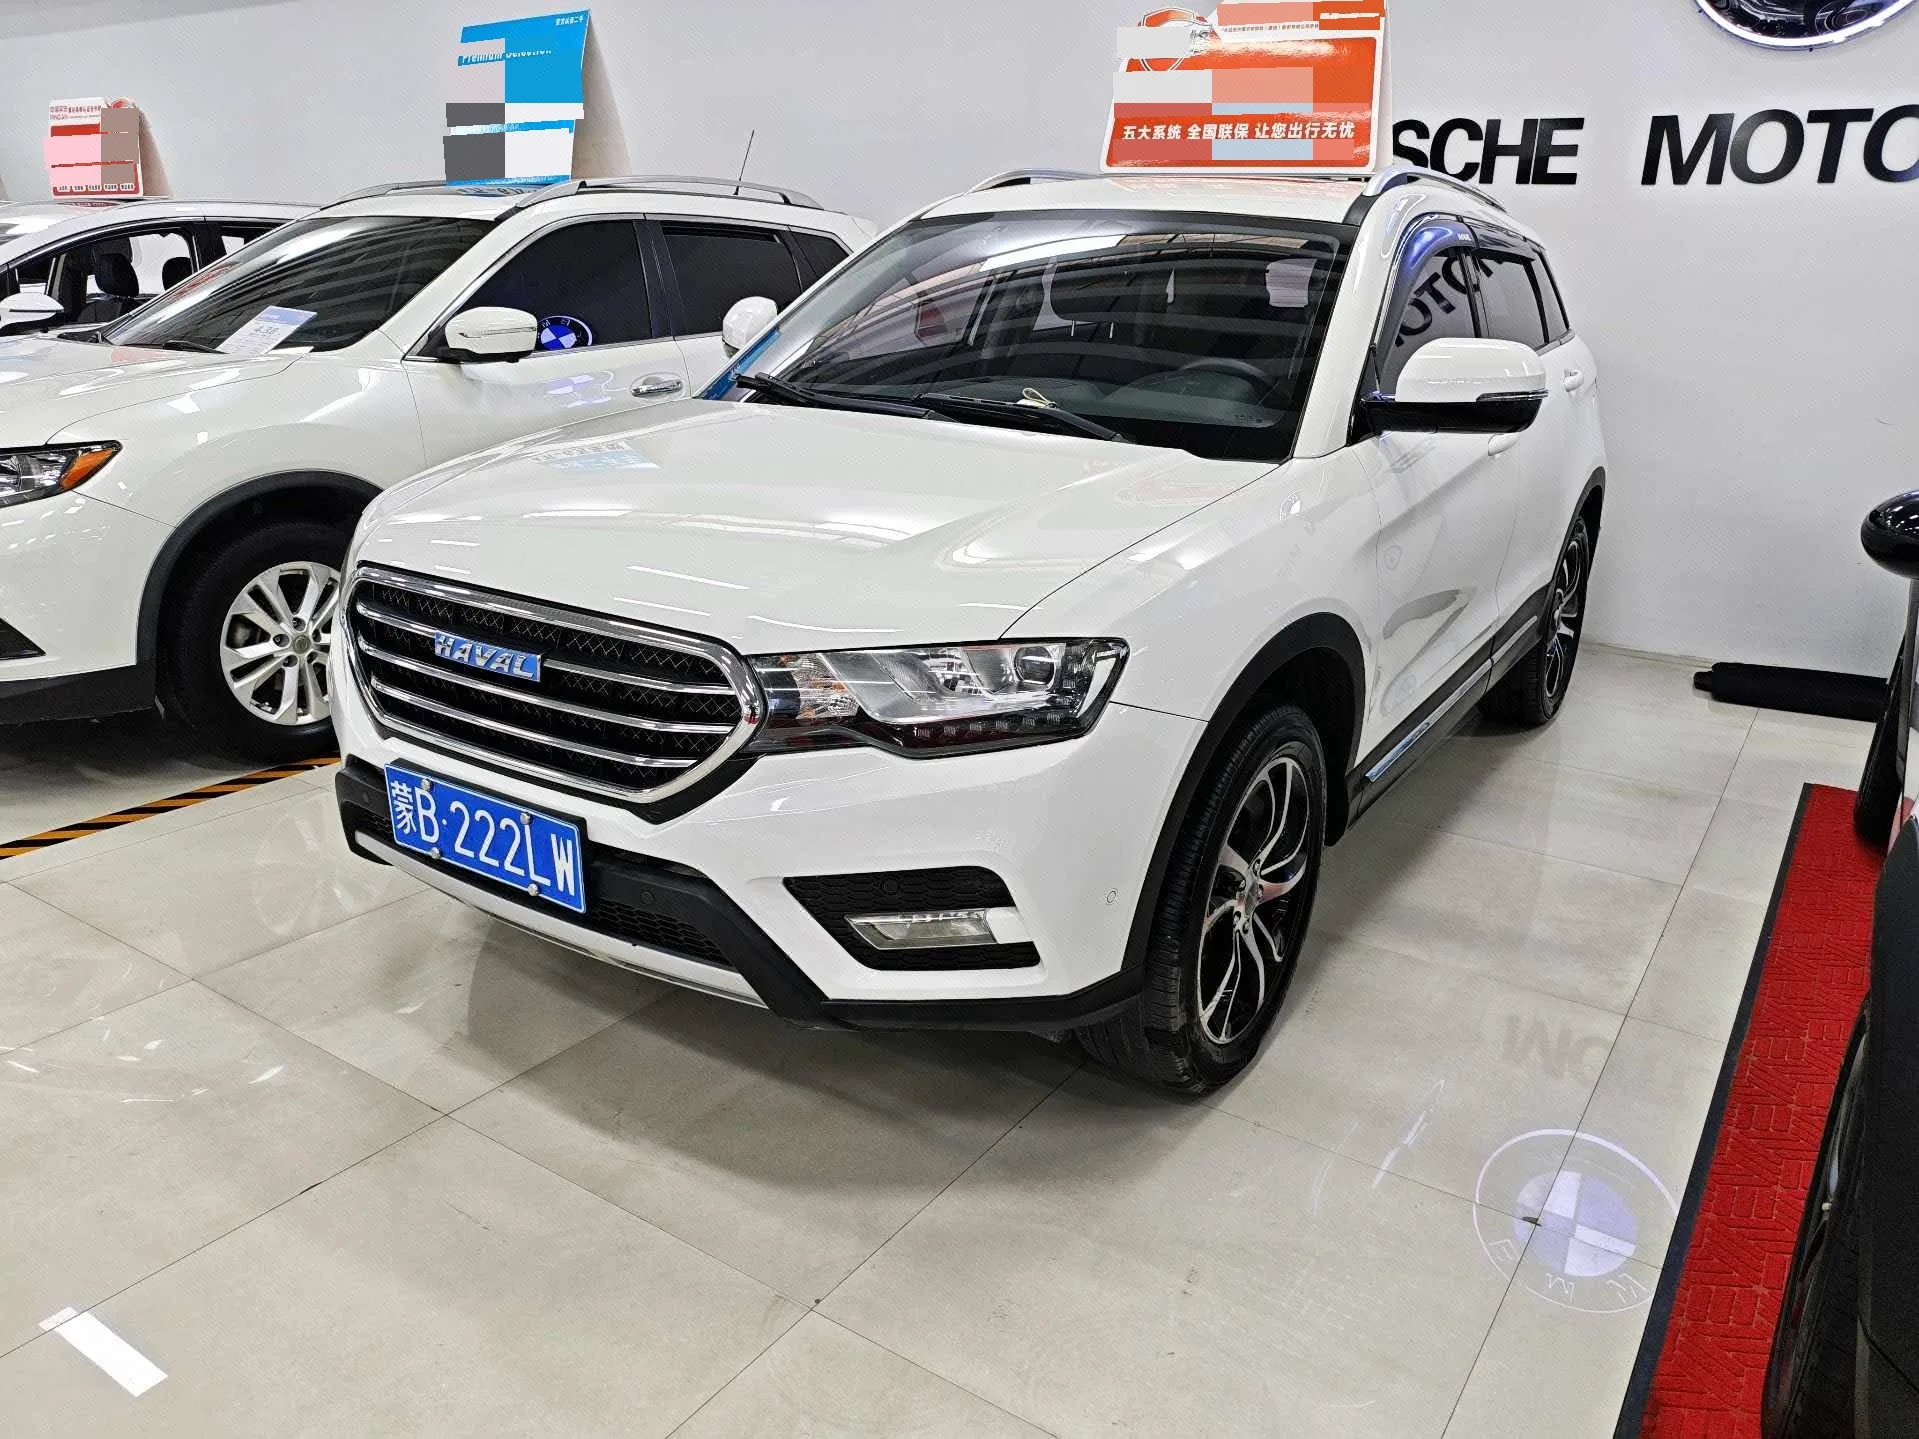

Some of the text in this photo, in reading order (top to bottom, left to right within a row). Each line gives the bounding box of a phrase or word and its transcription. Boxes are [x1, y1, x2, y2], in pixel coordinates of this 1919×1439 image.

[1122, 121, 1356, 140] 五大系统 全国联保 让您出行无忧
[1392, 104, 1919, 185] SCHE MOTO
[438, 634, 535, 679] HAVAL
